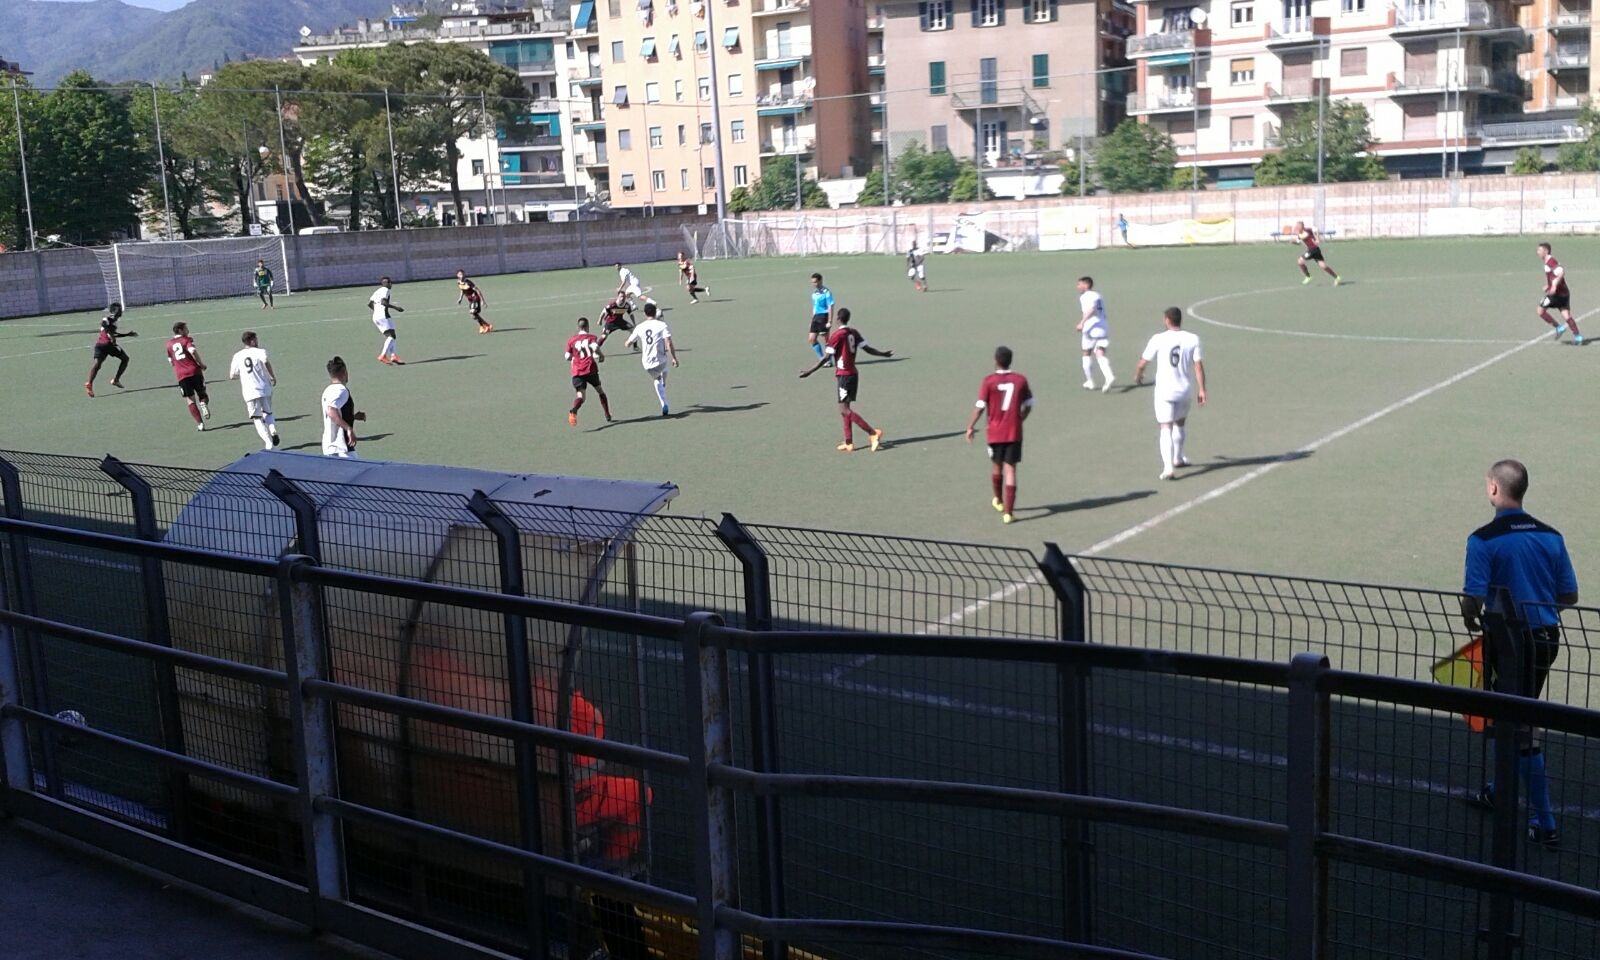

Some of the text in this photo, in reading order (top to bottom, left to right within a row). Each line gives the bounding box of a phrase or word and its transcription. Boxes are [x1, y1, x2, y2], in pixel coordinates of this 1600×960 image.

[644, 328, 654, 345] 8
[172, 342, 186, 360] 2
[574, 338, 592, 359] 11
[1169, 345, 1181, 368] 6
[243, 356, 254, 374] 9
[997, 382, 1015, 412] 7
